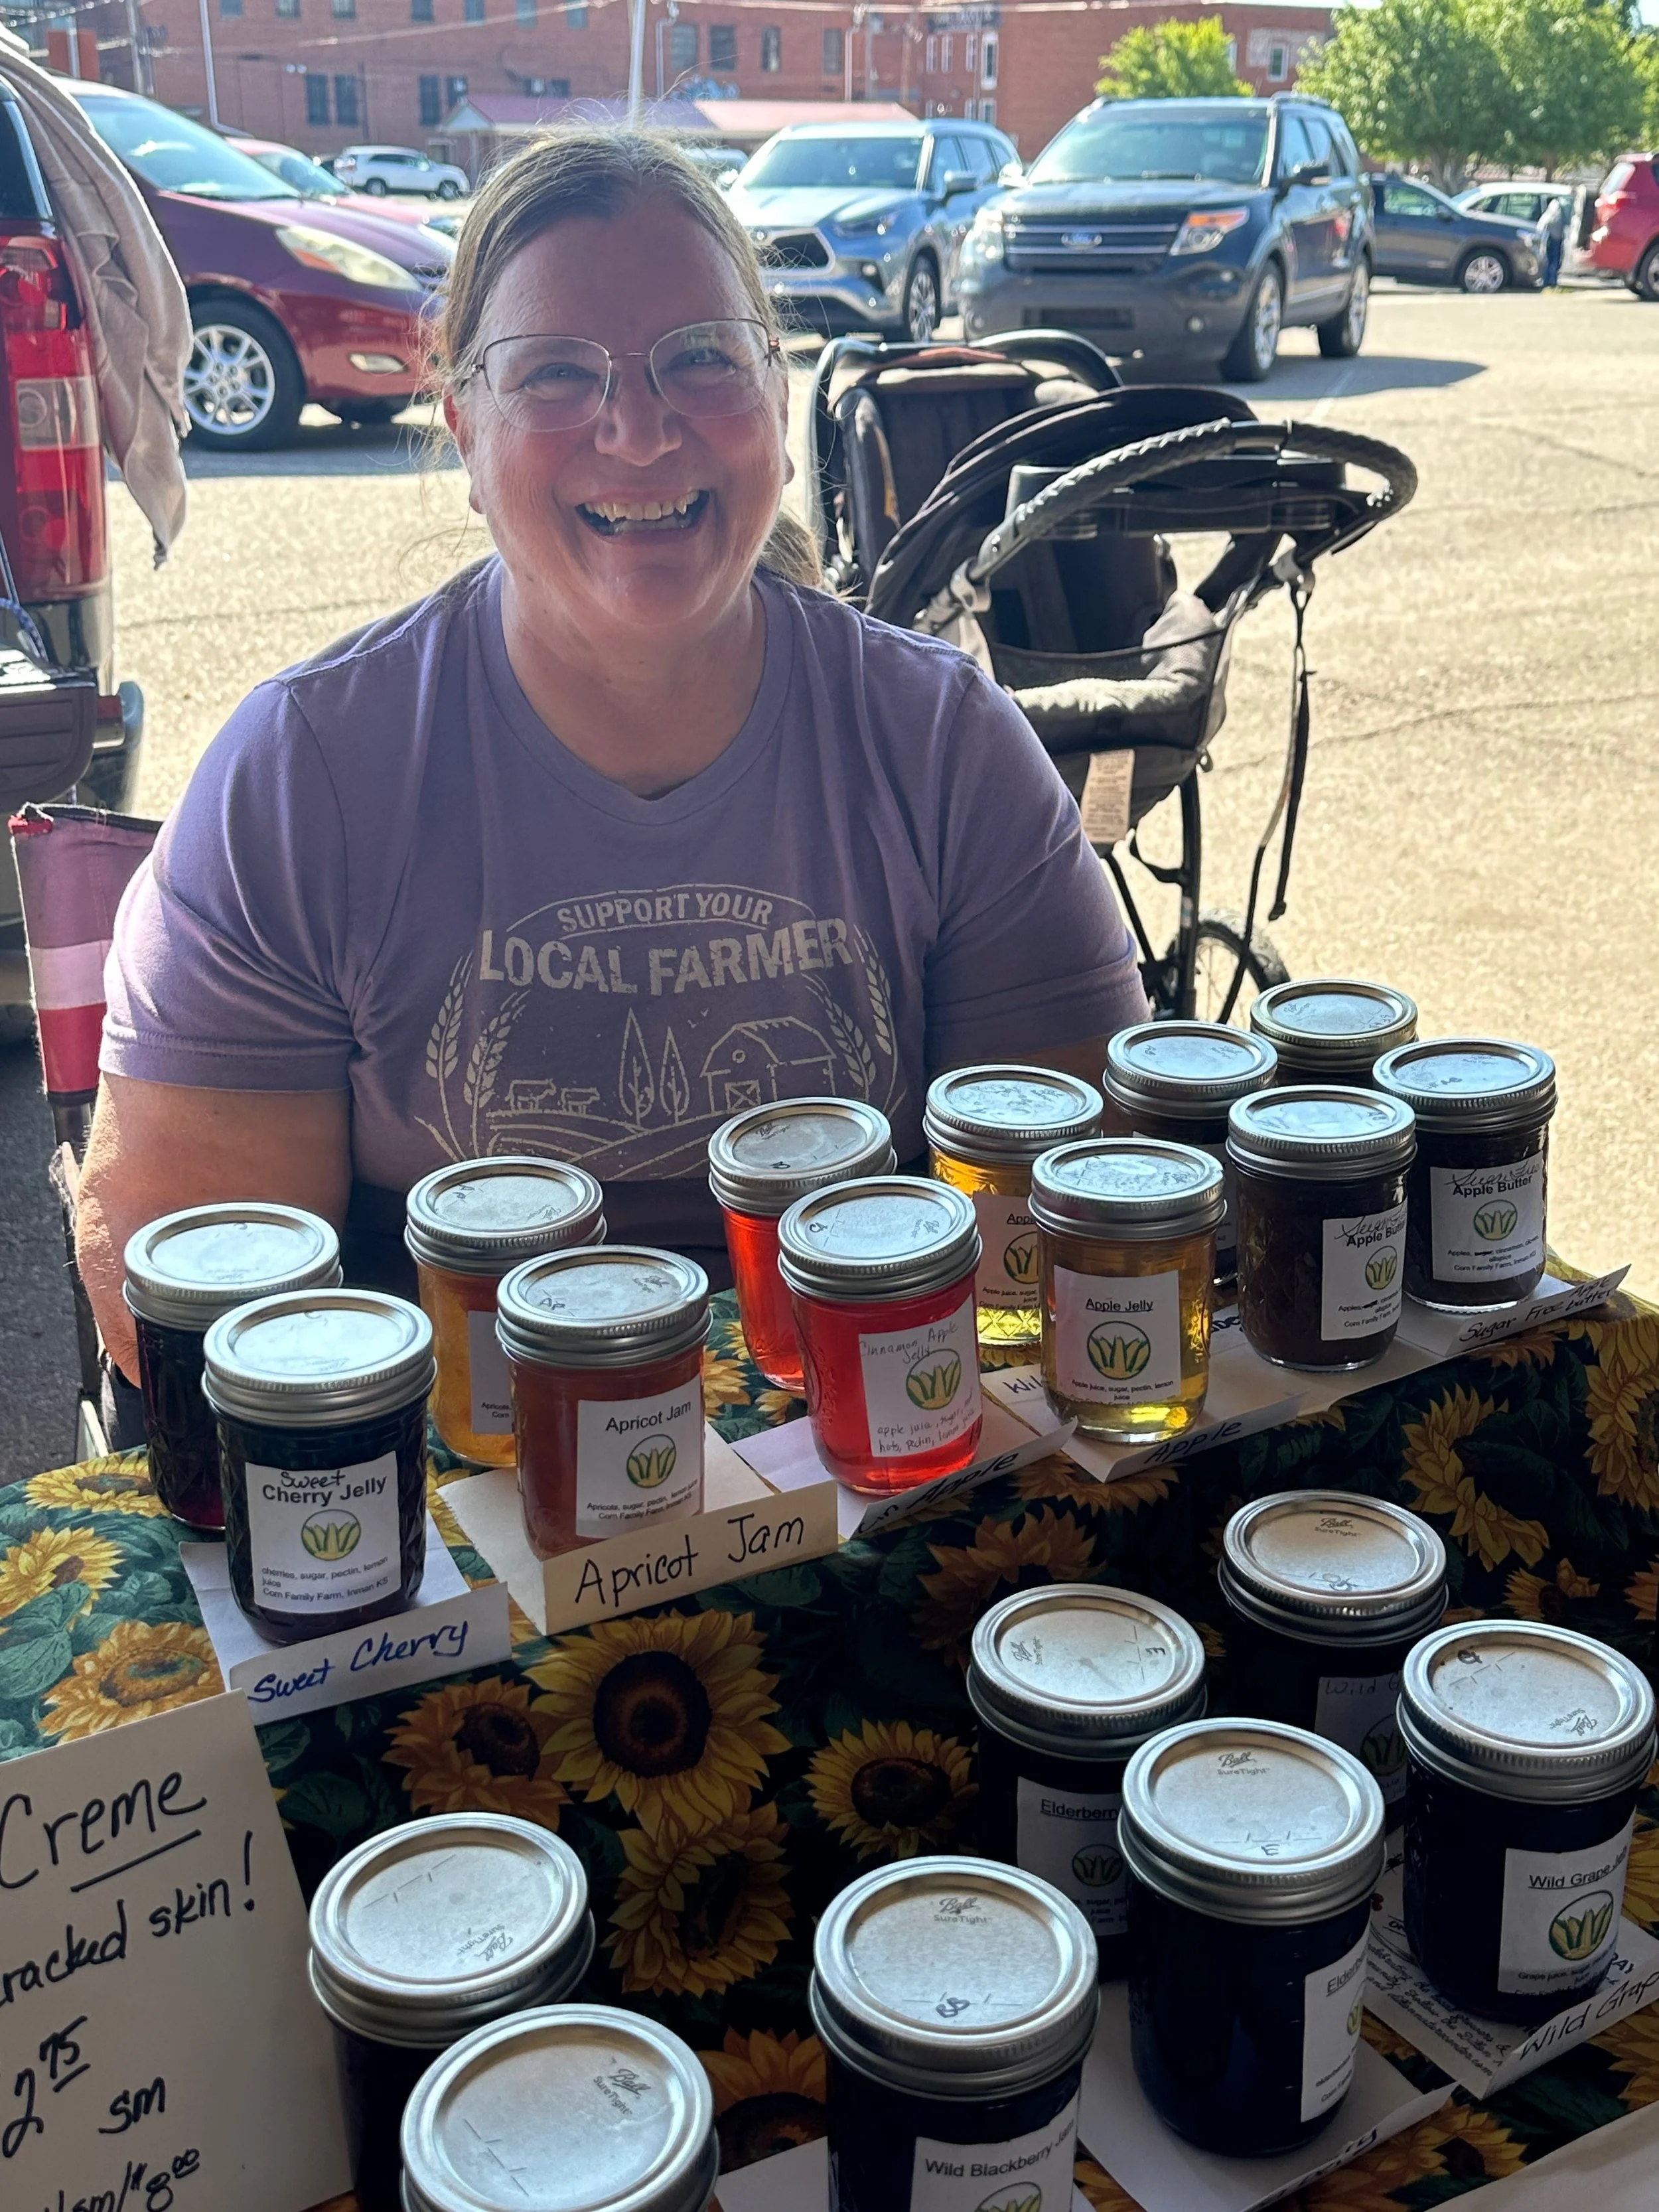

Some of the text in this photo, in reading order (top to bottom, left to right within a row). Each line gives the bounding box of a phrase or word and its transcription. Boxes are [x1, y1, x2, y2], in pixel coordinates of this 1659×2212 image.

[557, 891, 773, 932] SUPPORT YOUR
[479, 918, 854, 995] LOCAL FARMER
[1453, 1175, 1532, 1198] Apple Butter
[1346, 1232, 1382, 1248] Apple
[1085, 1298, 1154, 1313] Apple Jelly
[1459, 1317, 1517, 1342] Sugar
[1525, 1301, 1564, 1322] Free
[605, 1401, 691, 1434] Apricot Jam
[262, 1476, 388, 1507] Cherry Jelly
[281, 1470, 346, 1489] Sweet
[262, 1556, 388, 1581] cherries, sugar, pectin, lemon
[575, 1513, 804, 1607] Apricot Jam
[261, 1577, 281, 1587] juice
[285, 1593, 315, 1602] Family
[317, 1592, 344, 1601] Farm,
[347, 1584, 374, 1597] Inman
[376, 1576, 389, 1587] KS
[248, 1621, 469, 1702] Sweet Cherry
[1326, 1678, 1376, 1695] Wild
[1218, 1751, 1256, 1767] Ball
[0, 1772, 208, 1889] Creme
[1529, 1874, 1565, 1888] Wild
[1570, 1864, 1611, 1887] Grape
[0, 1831, 255, 2004] racked skin!
[940, 1897, 977, 1914] Ball
[473, 1932, 513, 1962] Ball
[1521, 1971, 1659, 2059] Wild Grap
[593, 2075, 633, 2115] SureTight
[607, 2068, 651, 2098] Ball
[926, 2159, 964, 2177] Wild
[970, 2143, 1052, 2177] Blackberry
